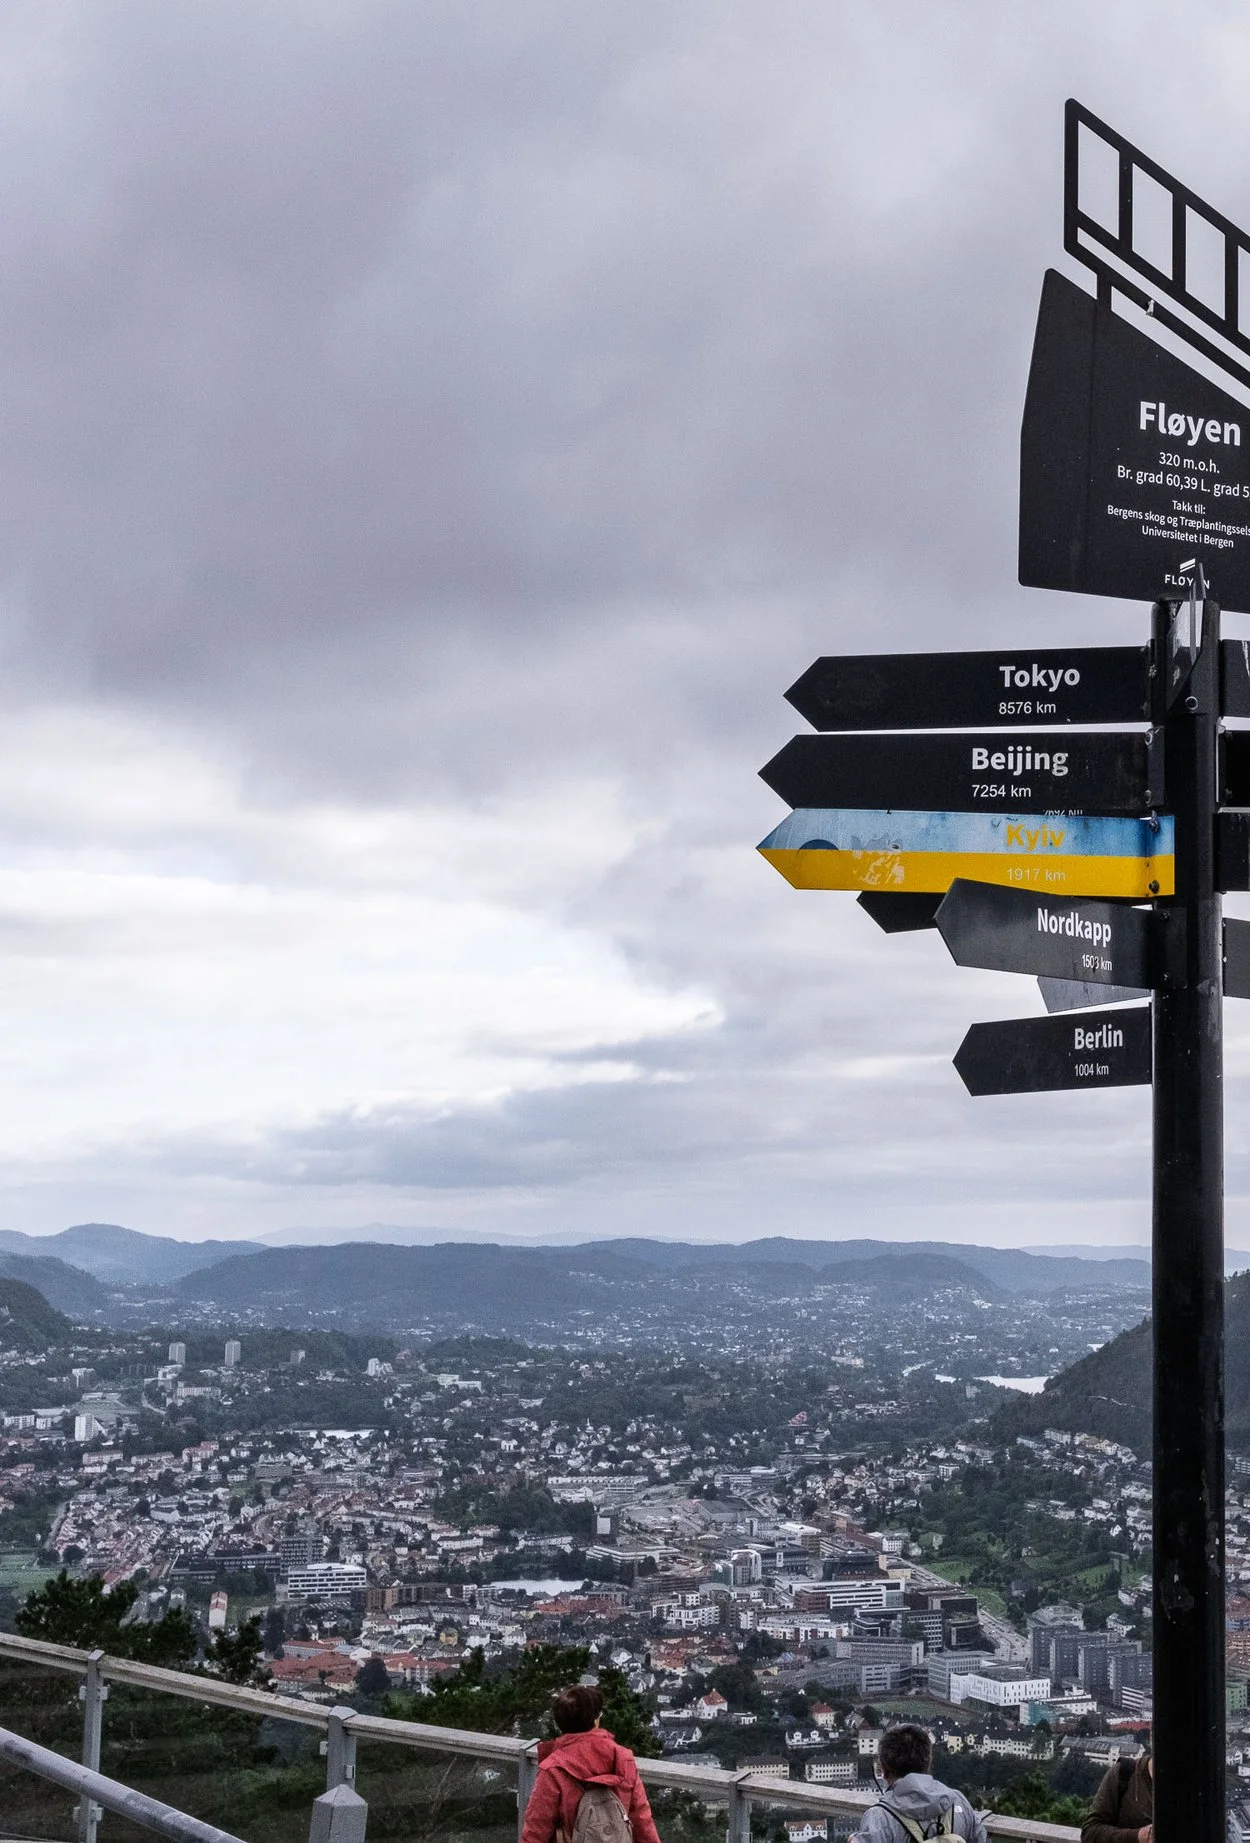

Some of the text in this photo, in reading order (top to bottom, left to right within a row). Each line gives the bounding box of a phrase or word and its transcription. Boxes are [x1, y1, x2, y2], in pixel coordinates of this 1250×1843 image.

[1139, 401, 1241, 446] Fløyen
[1159, 452, 1220, 474] 320 m.o.h.
[1117, 465, 1133, 480] Br.
[1136, 471, 1163, 484] grad
[1166, 474, 1198, 491] 60,39
[1201, 479, 1210, 492] L.
[1214, 484, 1239, 497] grad
[1107, 505, 1143, 520] Bergens
[1145, 511, 1166, 525] skog
[1167, 516, 1178, 528] og
[1172, 500, 1206, 515] Takk til:
[1142, 525, 1198, 543] Universitetet
[1204, 533, 1234, 548] Bergen
[999, 664, 1080, 692] Tokyo
[999, 702, 1056, 714] 8576 km
[973, 746, 1068, 776] Beijing
[972, 785, 1031, 797] 7254 km
[1006, 824, 1065, 853] Kyiv
[1007, 868, 1067, 882] 1917 km
[1038, 908, 1111, 947] Nordkapp
[1100, 956, 1112, 971] km
[1075, 1024, 1122, 1050] Berlin
[1075, 1063, 1108, 1076] 1004 km
